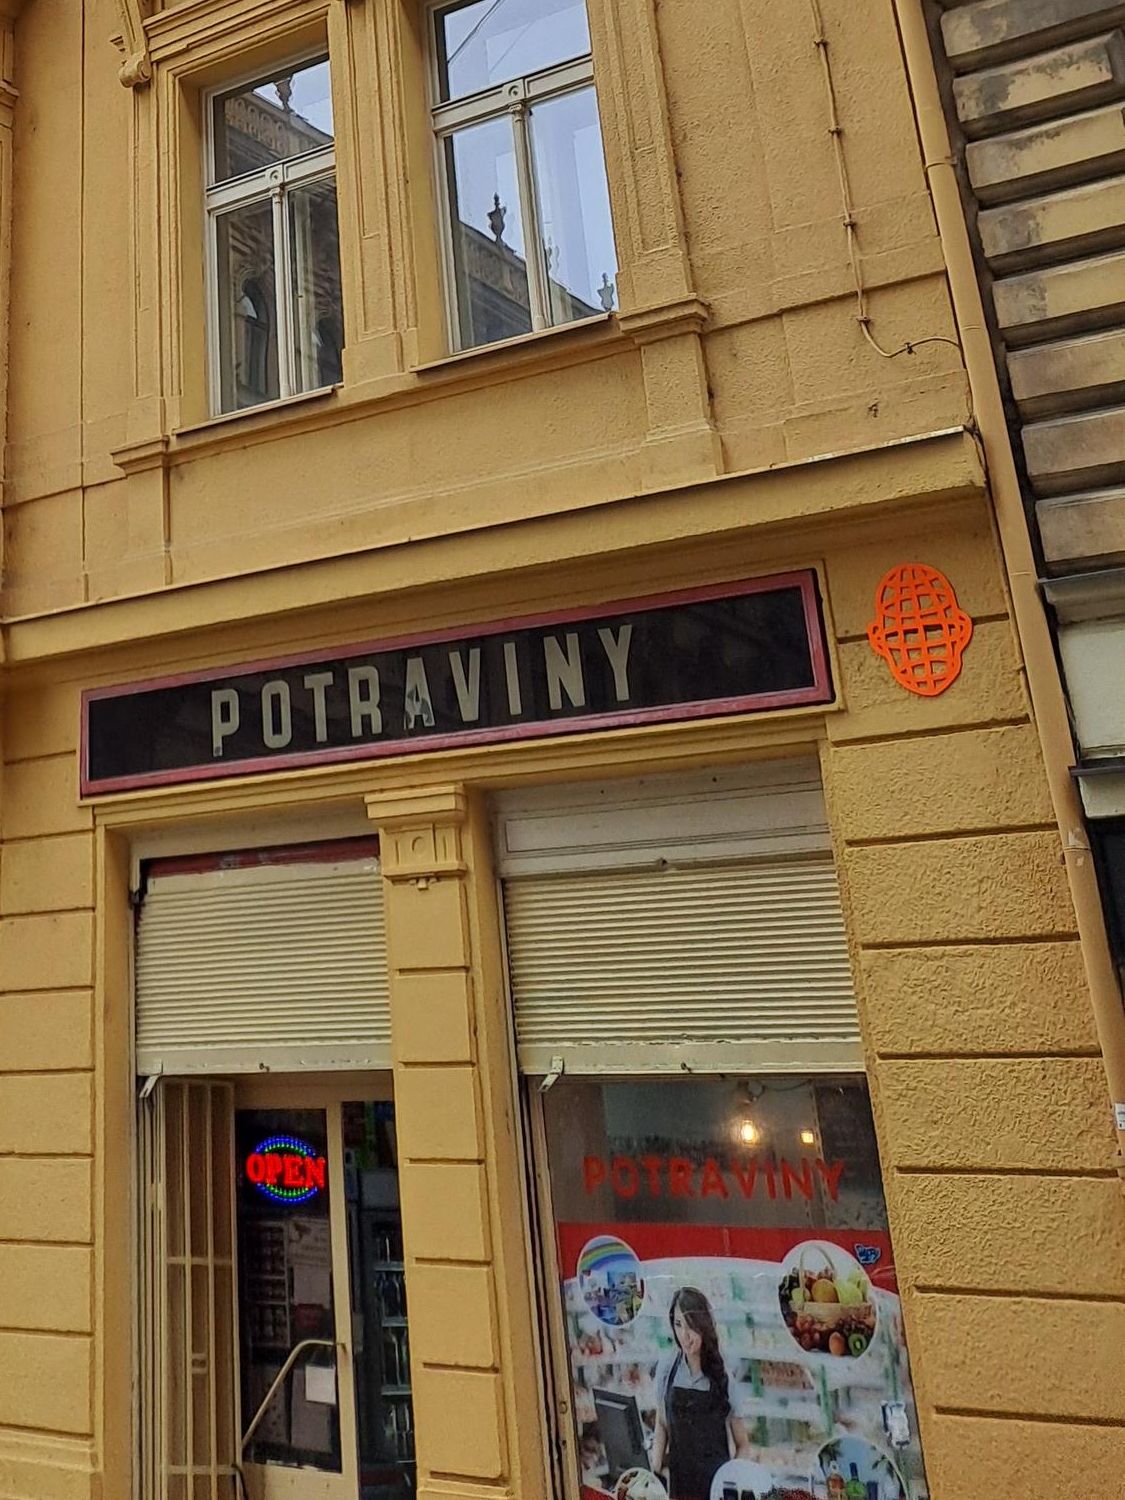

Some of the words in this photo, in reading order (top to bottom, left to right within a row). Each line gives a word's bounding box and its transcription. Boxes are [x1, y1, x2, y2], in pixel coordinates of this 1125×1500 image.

[211, 624, 634, 758] POTRAVINY
[245, 1152, 327, 1189] OPEN
[581, 1156, 847, 1203] POTRAVINY
